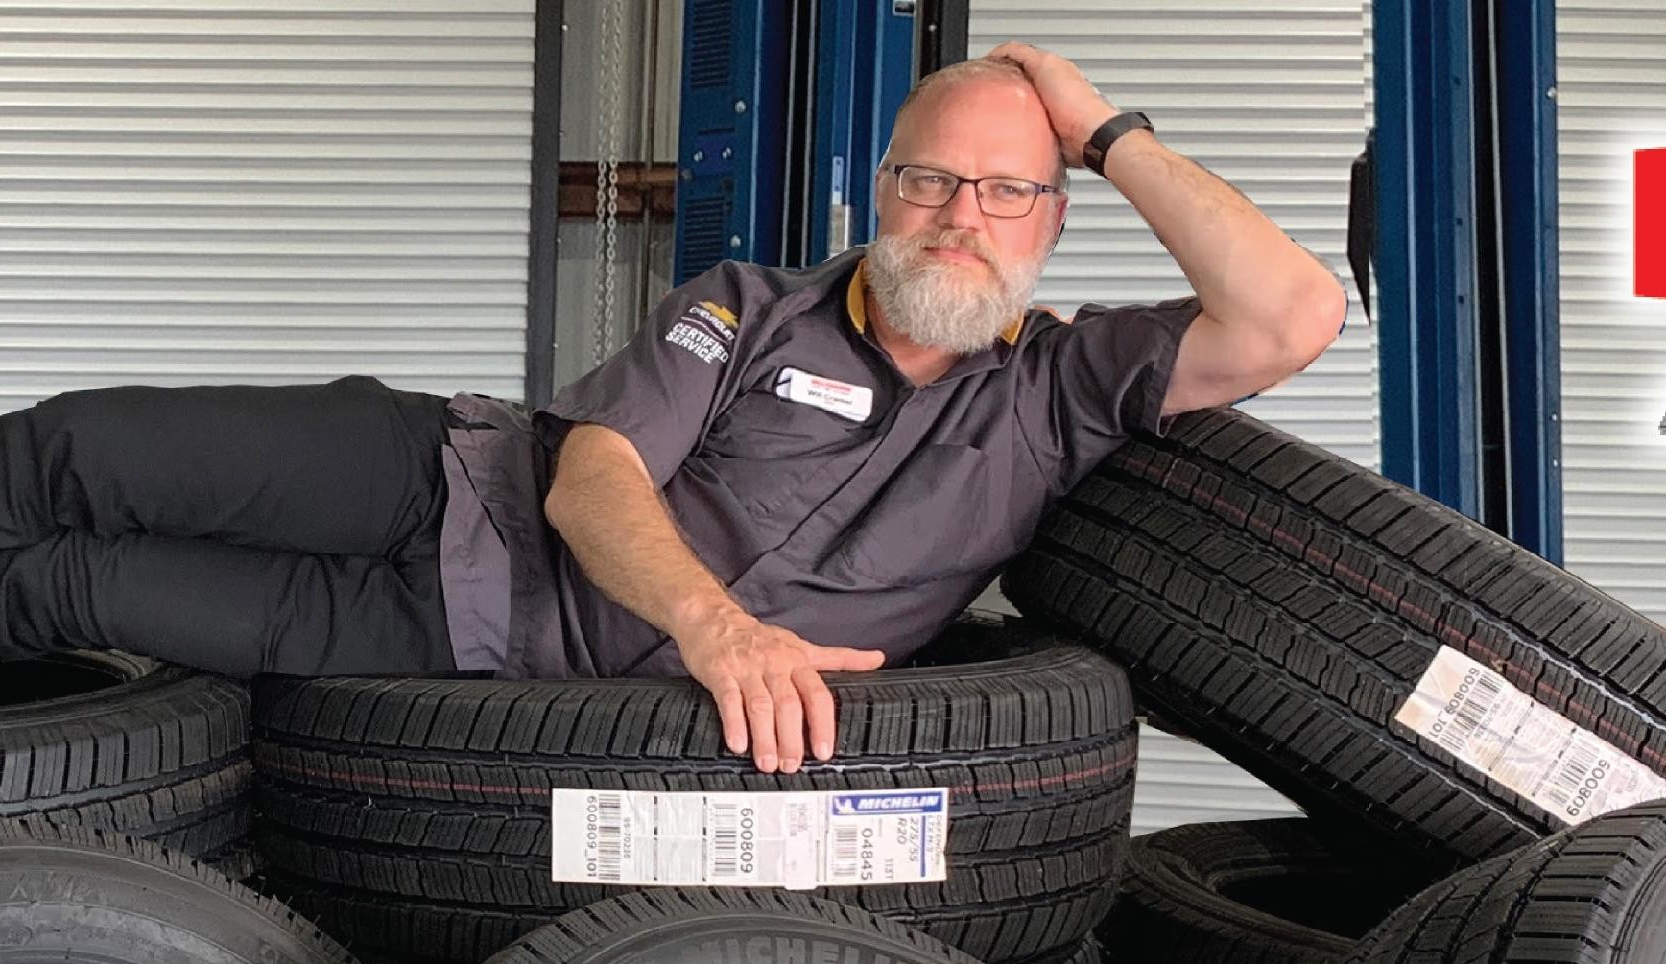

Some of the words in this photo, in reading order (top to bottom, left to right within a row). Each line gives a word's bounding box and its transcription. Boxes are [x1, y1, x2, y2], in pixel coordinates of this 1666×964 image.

[672, 321, 730, 363] CERTIFIED
[688, 306, 735, 340] CHEVROLET
[664, 330, 712, 364] SERVICE
[856, 795, 940, 811] MICHELIN
[1566, 758, 1612, 817] 600809
[740, 807, 754, 874] 600809
[896, 817, 907, 845] R20
[908, 817, 919, 862] 275/55
[861, 827, 874, 881] 04845
